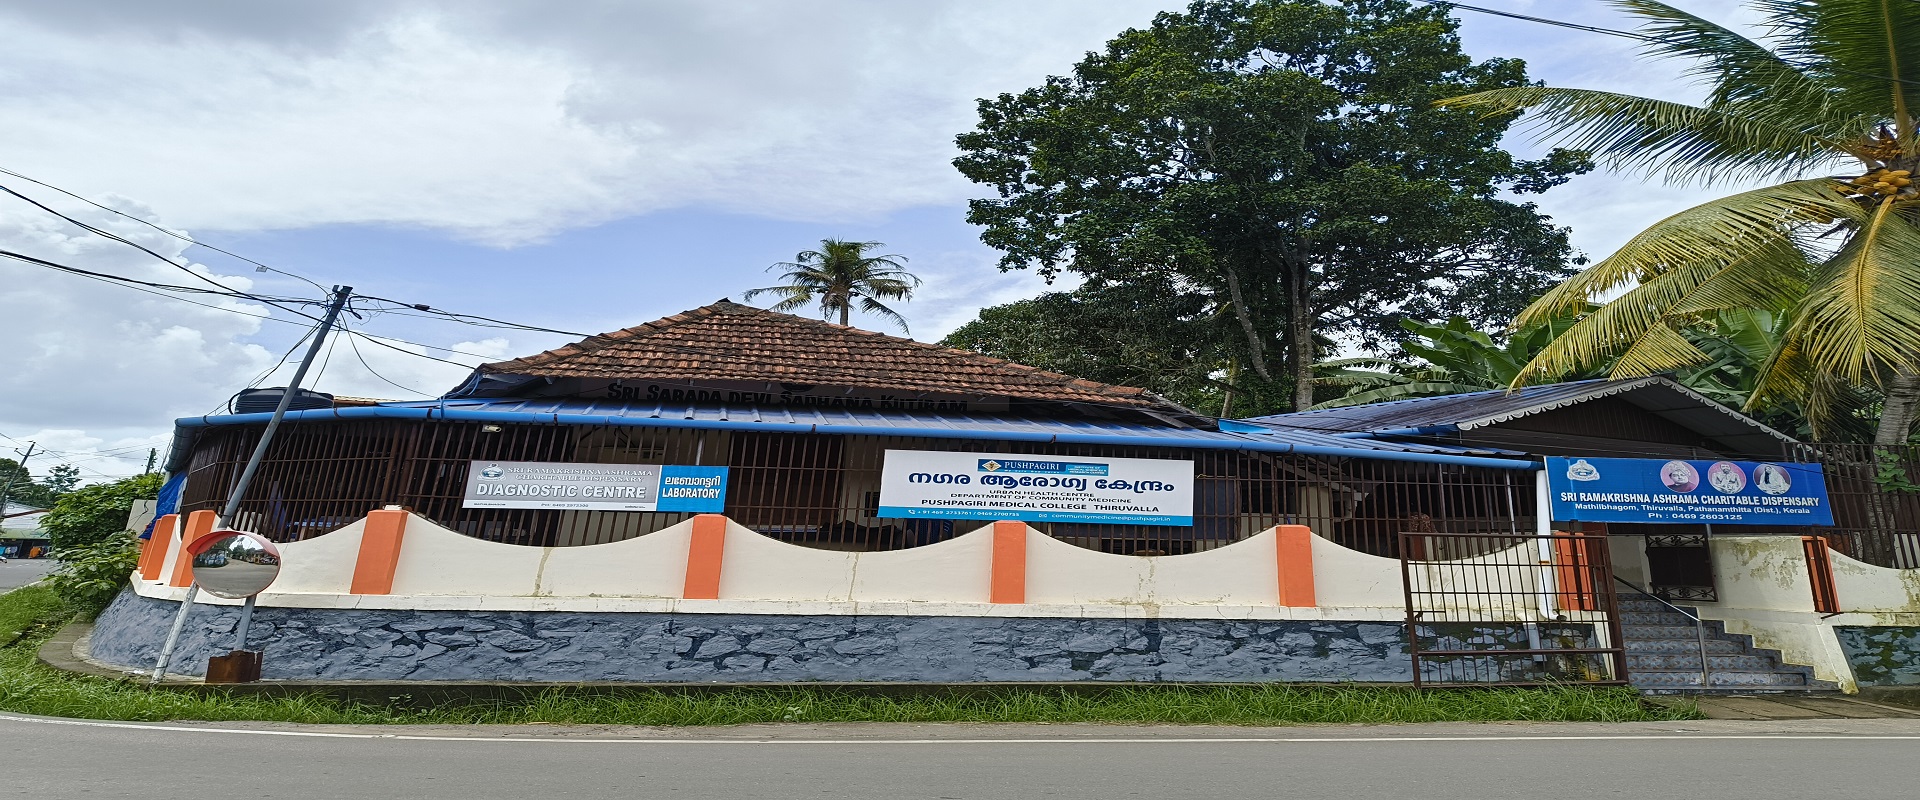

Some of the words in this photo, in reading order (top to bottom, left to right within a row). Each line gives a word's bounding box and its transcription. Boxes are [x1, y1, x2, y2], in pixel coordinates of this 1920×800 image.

[1004, 461, 1060, 470] PUSHPAGIRI
[909, 472, 971, 485] നഗര
[980, 474, 1087, 491] ആരോഗ്യ
[1094, 478, 1175, 493] കേന്ദ്രം
[476, 483, 579, 497] DIAGNOSTIC
[582, 484, 646, 499] CENTRE
[662, 487, 721, 499] LABORATORY
[1560, 492, 1577, 502] SRI
[1579, 492, 1651, 503] RAMAKRISHNA
[1652, 494, 1699, 504] ASHRAMA
[1701, 495, 1760, 505] CHARITABLE
[1762, 496, 1819, 506] DISPENSARY
[921, 499, 986, 507] PUSHPAGIRI
[1040, 502, 1088, 510] COLLEGE
[1093, 504, 1160, 513] THIRUVALLA
[1575, 503, 1639, 512] Mathilbhagom,
[1641, 504, 1686, 512] Thiruvalla,
[1688, 505, 1752, 513] Pathanamthitta
[1754, 506, 1781, 514] (Dist.),
[1051, 513, 1171, 522] communitymedicine@pushpagiri.in
